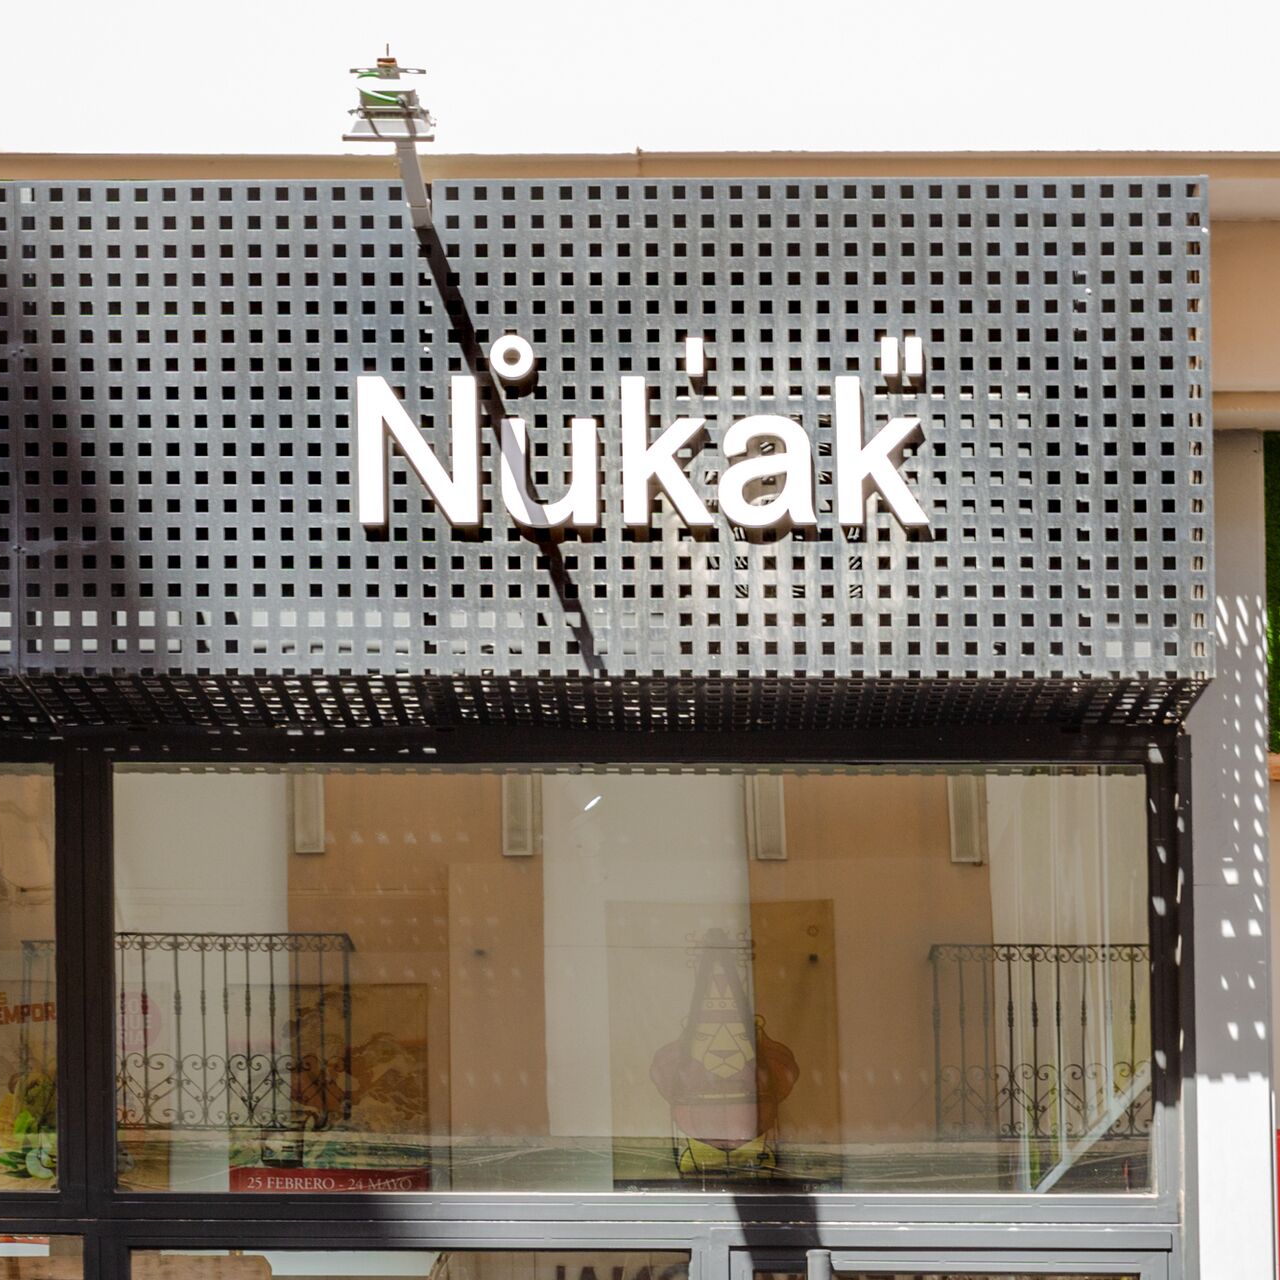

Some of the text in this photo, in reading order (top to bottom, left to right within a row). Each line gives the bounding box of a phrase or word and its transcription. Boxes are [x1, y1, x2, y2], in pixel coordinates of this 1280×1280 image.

[247, 1177, 262, 1190] 25
[267, 1177, 335, 1190] FEBRERO
[349, 1177, 364, 1190] 24
[368, 1177, 412, 1191] MAYO
